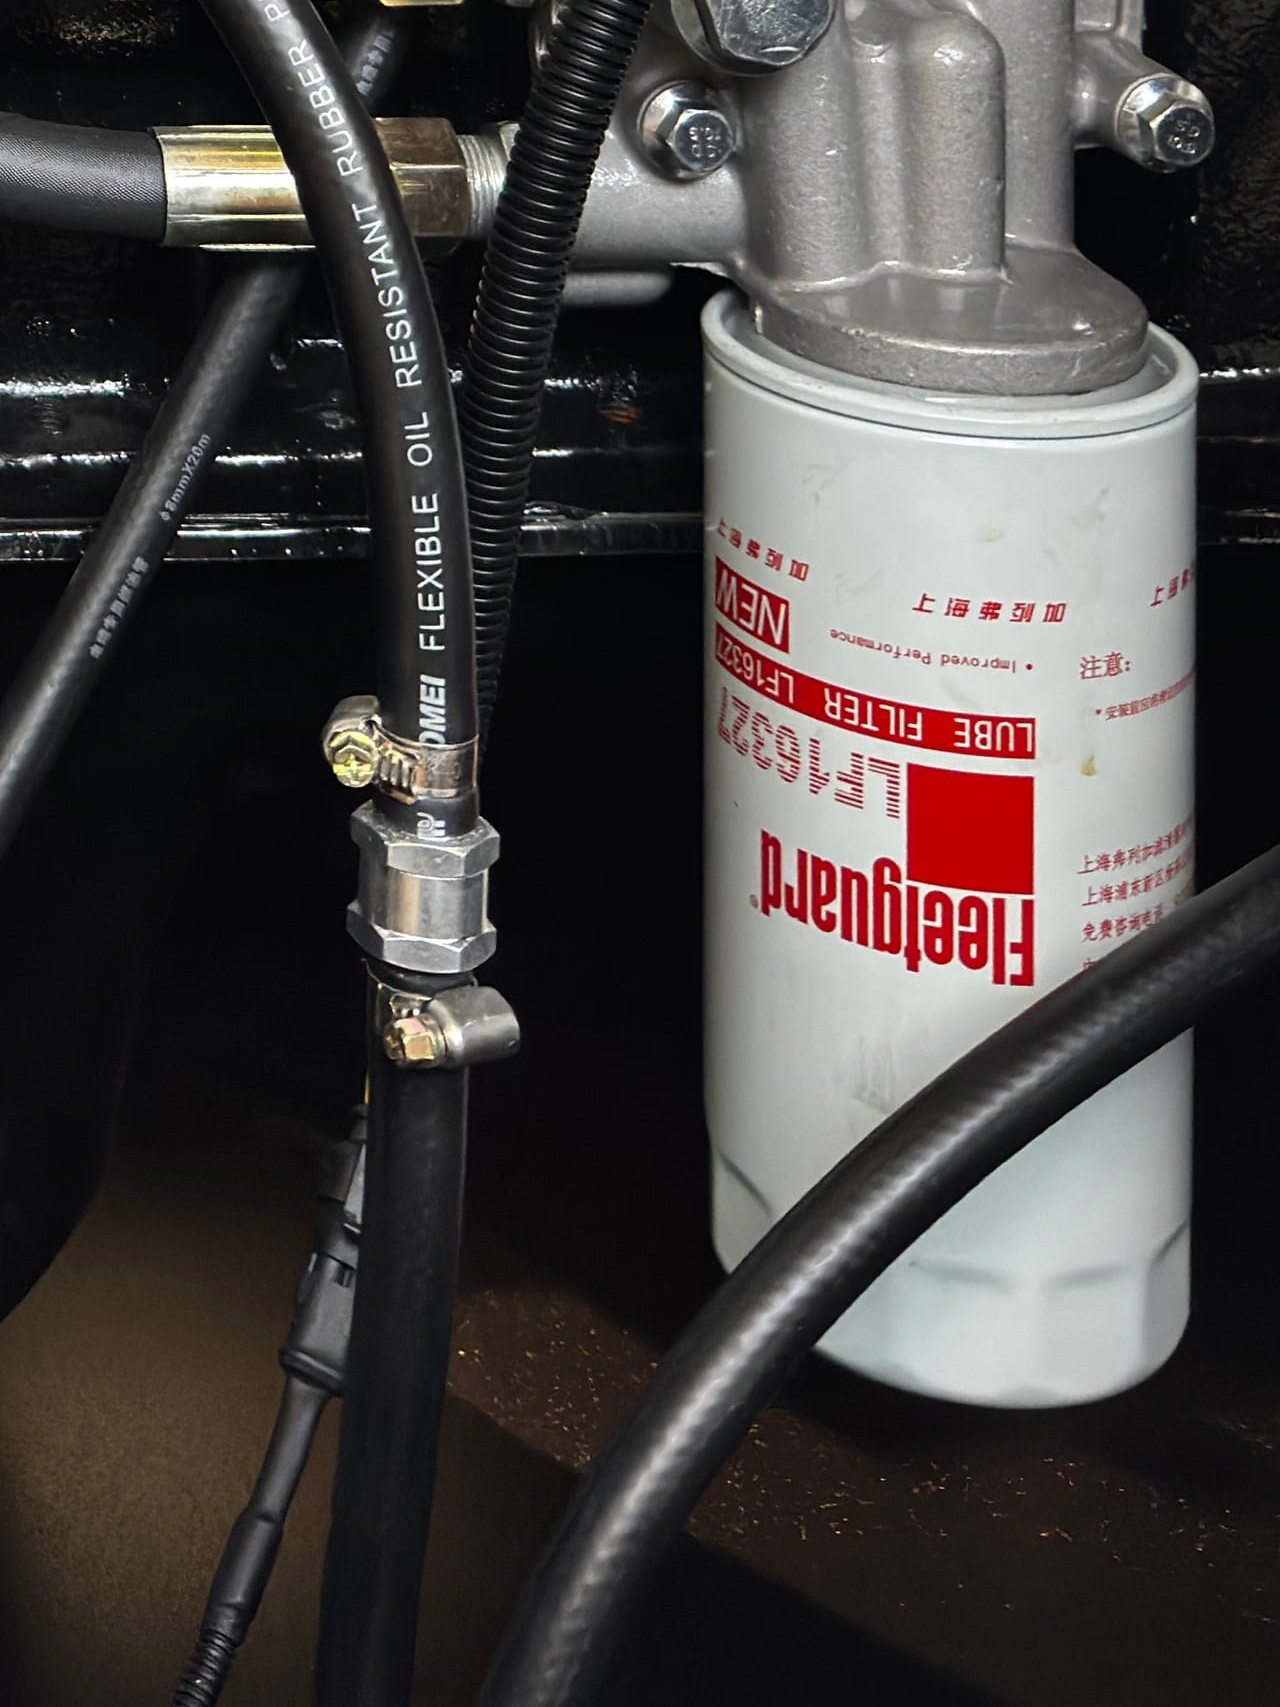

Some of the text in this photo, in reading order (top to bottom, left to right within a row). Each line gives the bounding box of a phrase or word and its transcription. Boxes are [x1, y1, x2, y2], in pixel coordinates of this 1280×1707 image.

[287, 38, 364, 178] RUBBER
[351, 202, 423, 389] RESISTANT
[405, 411, 432, 468] OIL
[411, 491, 445, 651] FLEXIBLE
[716, 568, 786, 645] NEW
[912, 593, 1066, 622] 上海弗列加
[830, 629, 1016, 673] Improved Performance
[718, 687, 900, 819] LF16327
[824, 688, 922, 741] FILTER
[954, 718, 1033, 752] LUBE
[761, 830, 1034, 987] Fleetguard
